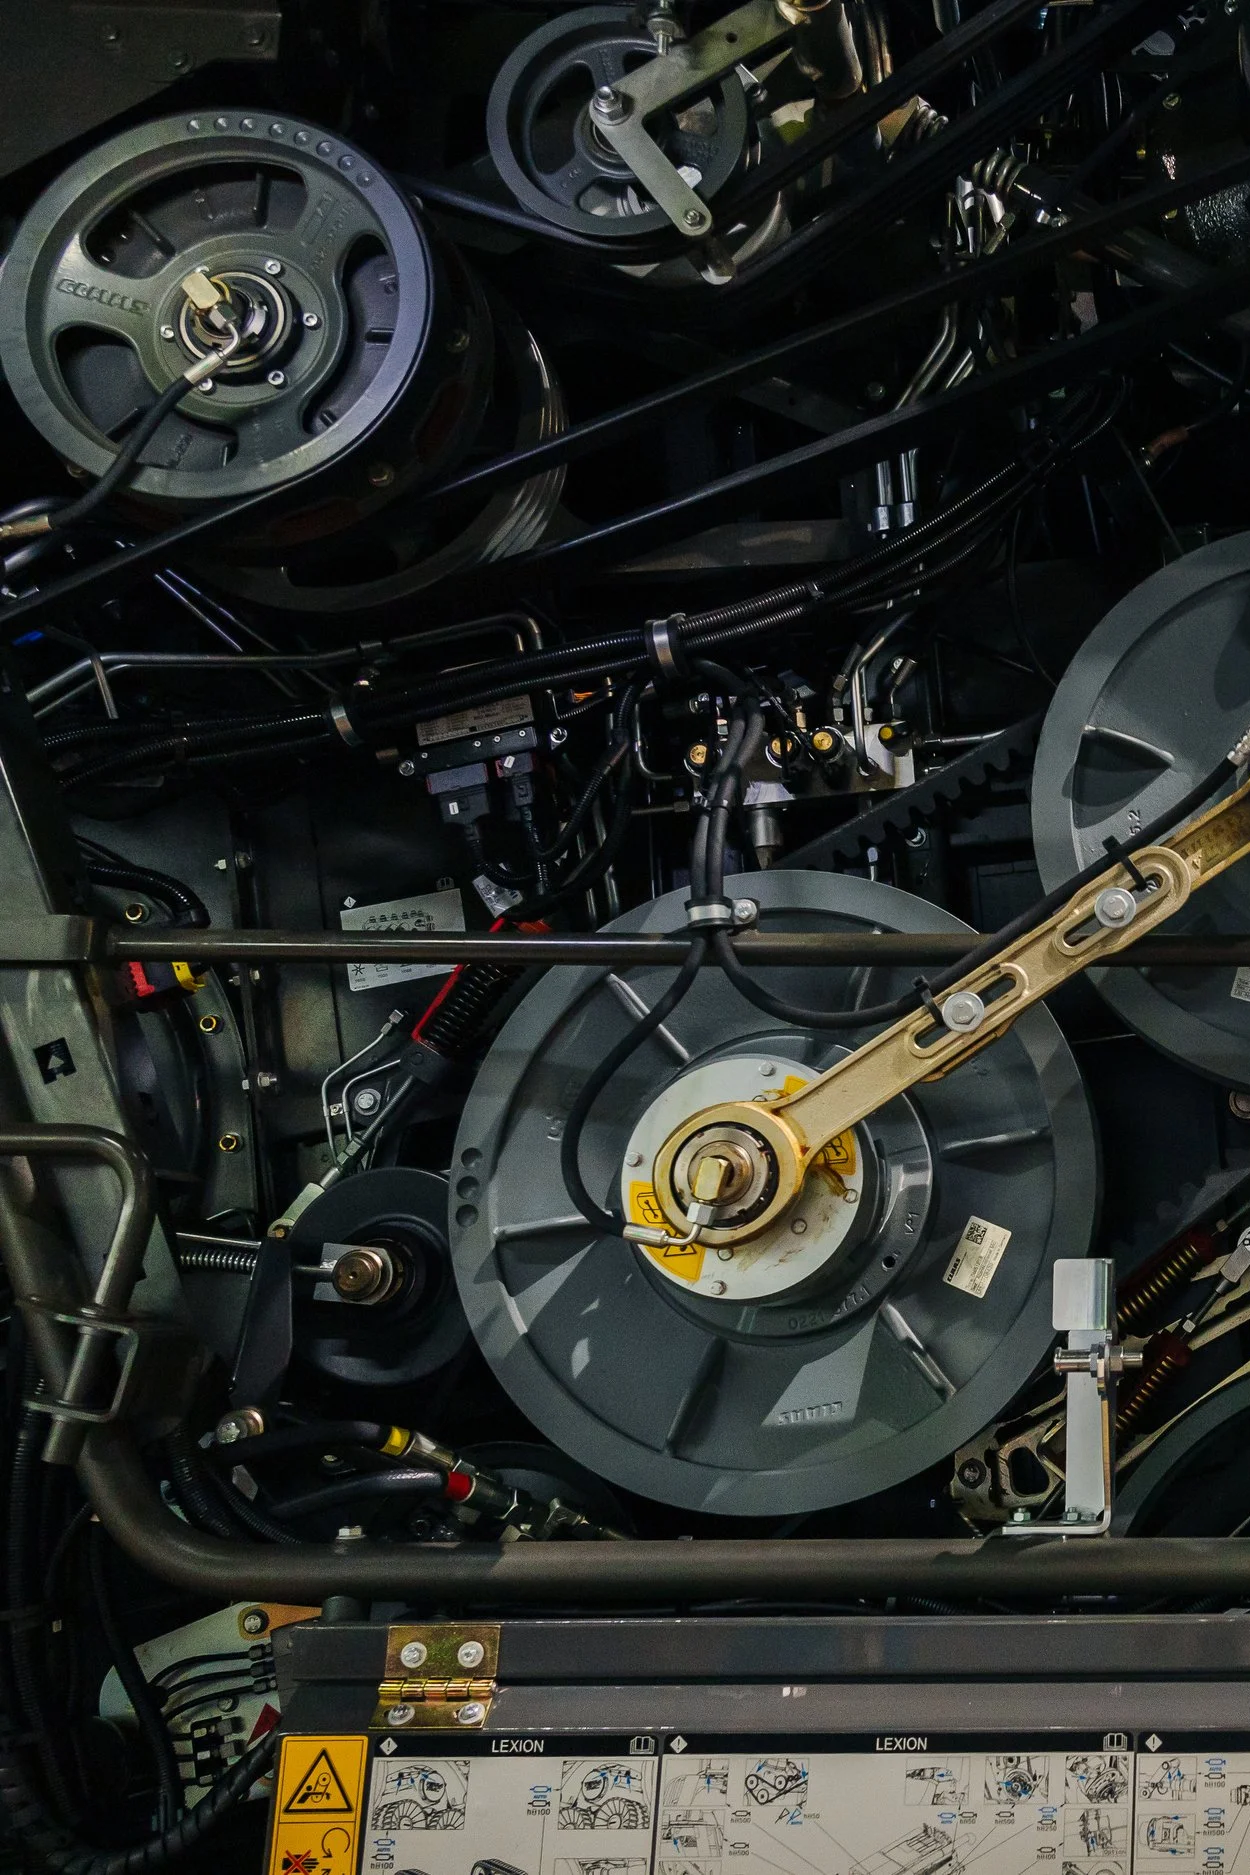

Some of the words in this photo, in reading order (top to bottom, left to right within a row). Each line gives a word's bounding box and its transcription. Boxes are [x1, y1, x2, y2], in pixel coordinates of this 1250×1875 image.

[906, 1212, 920, 1235] VP1
[946, 1258, 961, 1283] CLAAS
[491, 1739, 545, 1753] LEXION
[875, 1737, 928, 1751] LEXION
